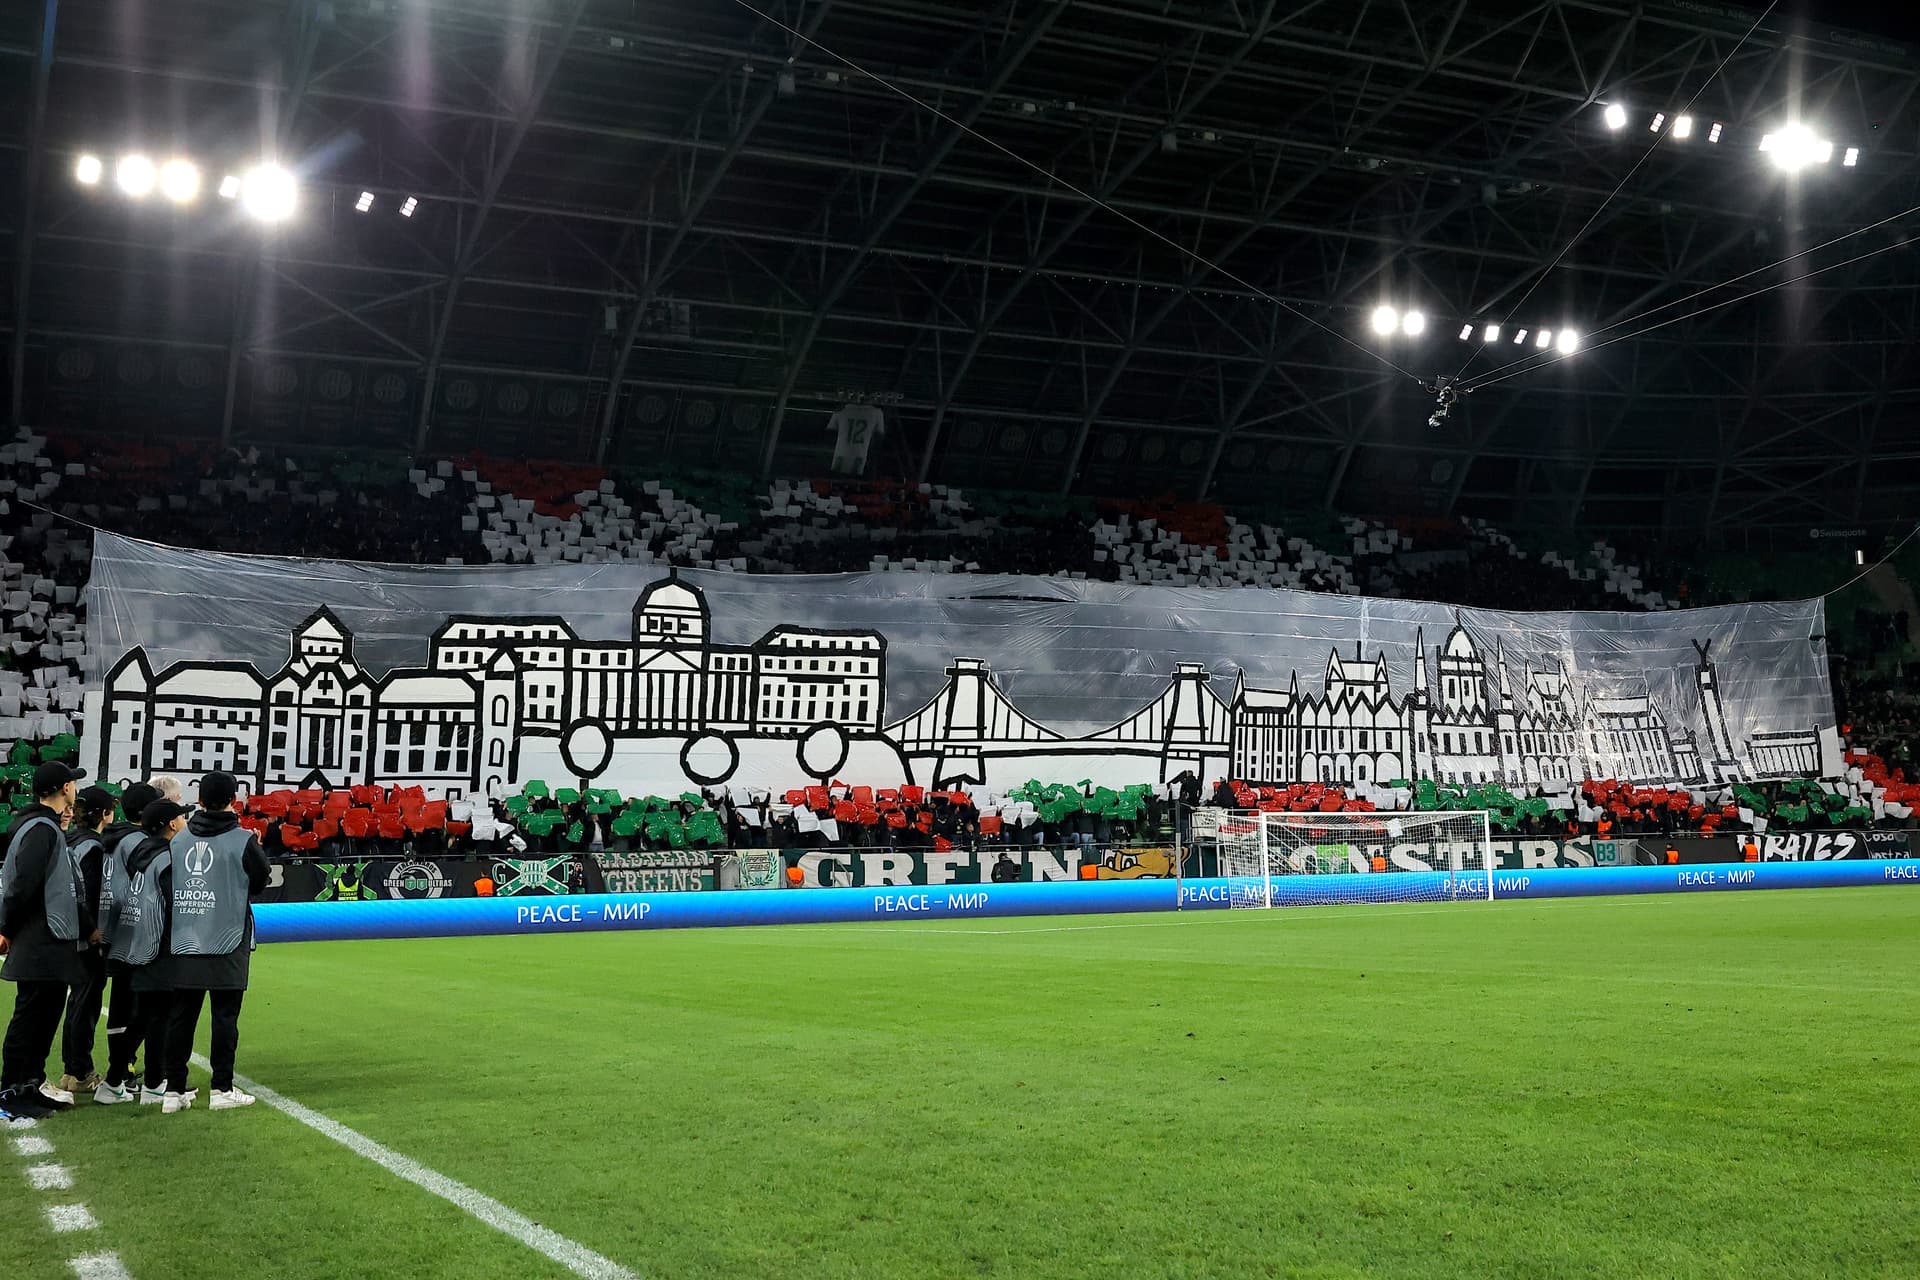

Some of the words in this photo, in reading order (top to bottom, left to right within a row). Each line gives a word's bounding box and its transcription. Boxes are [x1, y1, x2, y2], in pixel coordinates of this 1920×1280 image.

[847, 417, 868, 444] 12
[1678, 871, 1716, 885] PEACE
[1727, 870, 1755, 884] МИР
[1885, 865, 1918, 879] PEACE
[604, 868, 703, 893] GREENS
[1443, 878, 1485, 893] PEACE
[1498, 877, 1530, 891] МИР
[174, 890, 216, 901] EUROPA
[1181, 885, 1229, 902] PEACE
[174, 900, 216, 908] CONFERENCE
[874, 894, 930, 912] PEACE
[948, 892, 988, 910] МИР
[517, 904, 582, 924] PEACE
[603, 902, 651, 921] МИР
